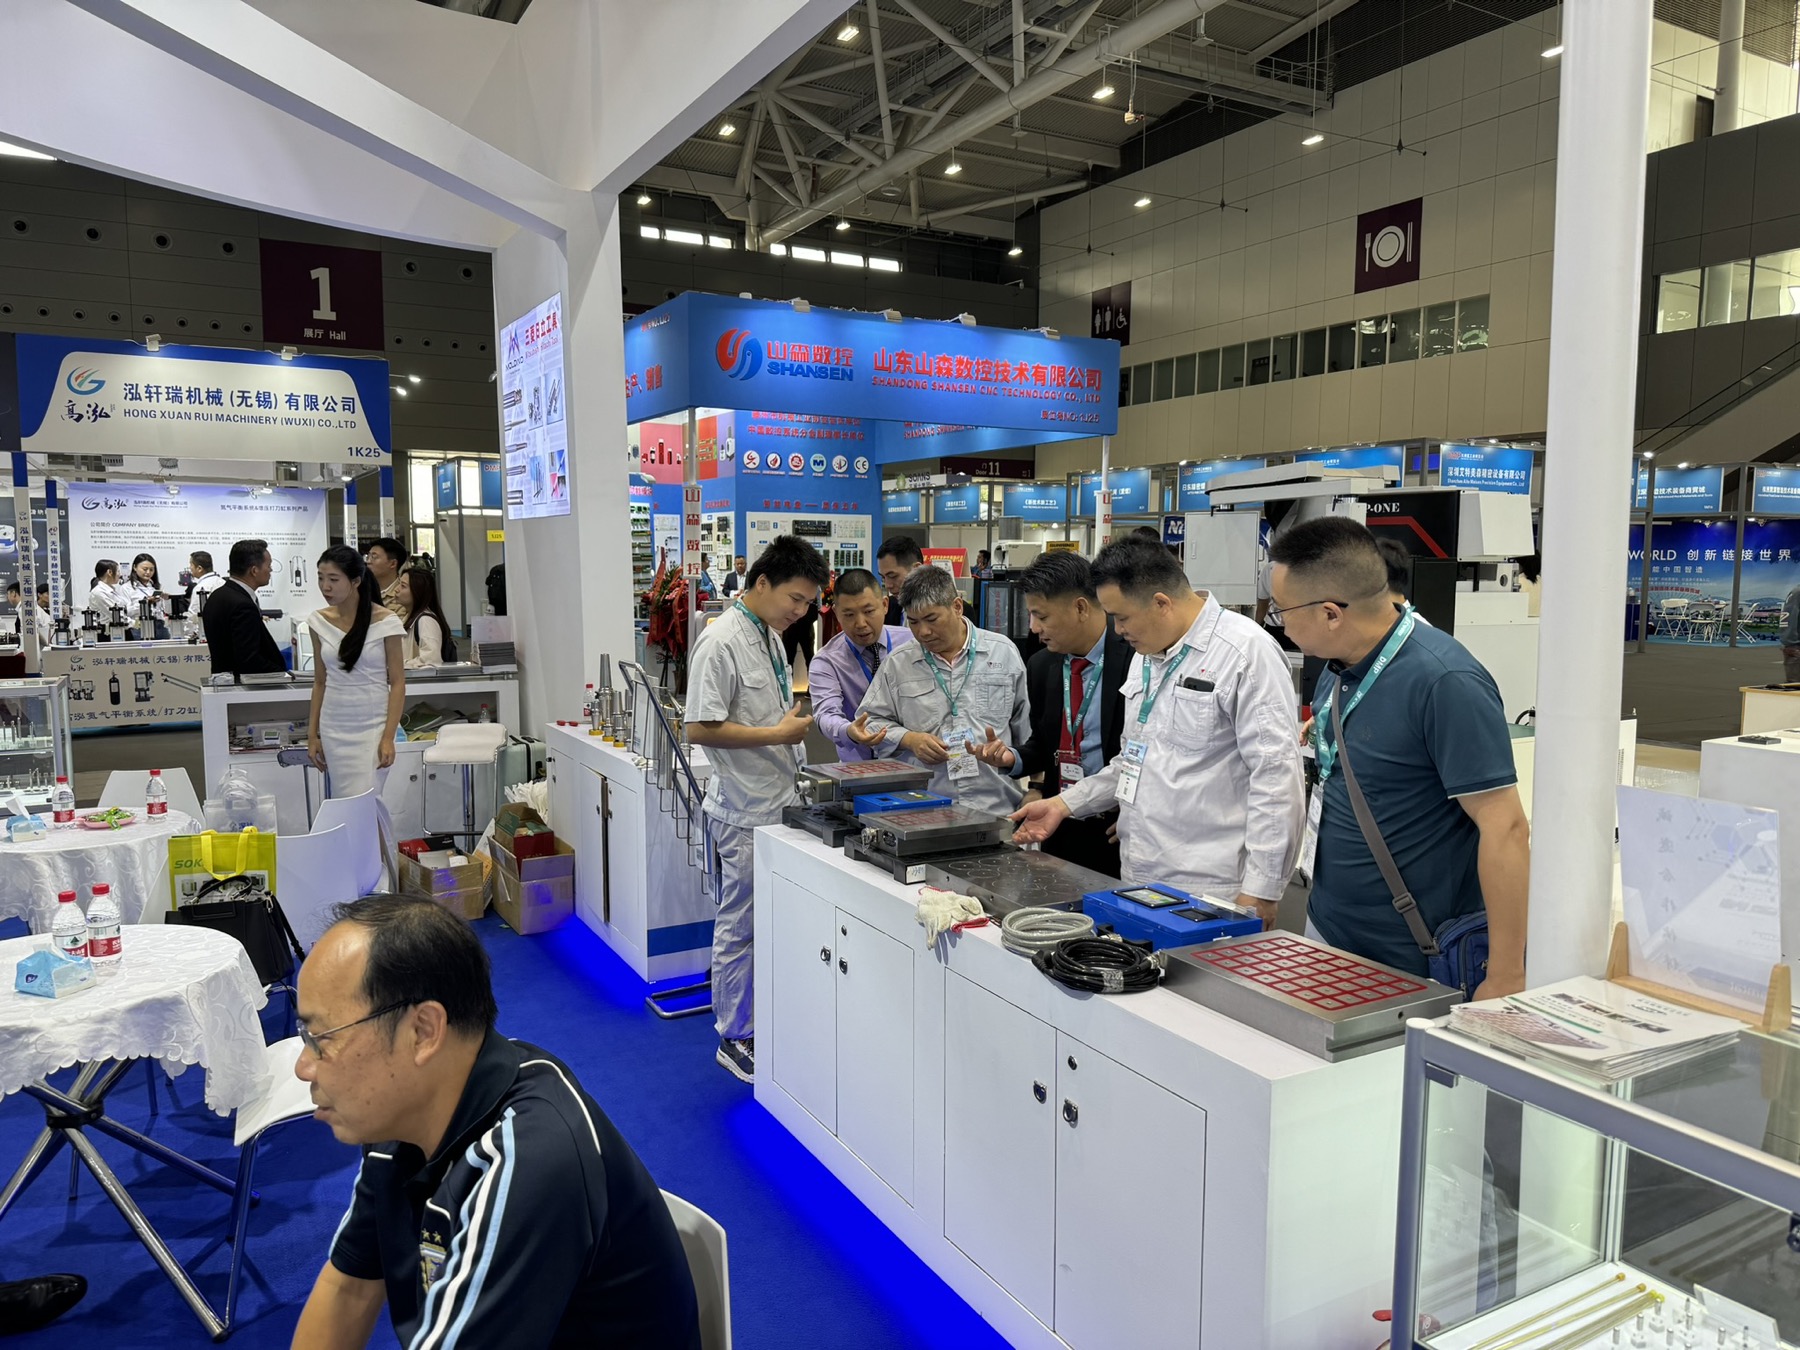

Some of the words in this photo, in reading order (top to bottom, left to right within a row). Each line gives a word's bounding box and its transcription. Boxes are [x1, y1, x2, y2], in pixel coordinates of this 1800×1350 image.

[310, 267, 337, 320] 1
[303, 328, 324, 339] 展厅
[329, 331, 347, 341] Hall
[525, 311, 558, 347] 三菱日立工具
[766, 360, 854, 381] SHANSEN
[873, 346, 1102, 392] 山东山森数控技术有限公司
[123, 382, 357, 415] 泓轩瑞机械（无锡）有限公司
[871, 375, 928, 390] SHANDONG
[931, 382, 977, 395] SHANSEN
[979, 386, 998, 396] CNC
[1001, 387, 1062, 401] TECHNOLOGY
[1063, 392, 1082, 404] CO.,
[1084, 393, 1101, 403] LTD
[123, 409, 157, 420] HONG
[160, 410, 192, 421] XUAN
[194, 412, 213, 422] RUI
[215, 413, 278, 425] MACHINERY
[280, 416, 316, 428] (WUXI)
[317, 418, 357, 429] CO.,LTD
[347, 445, 381, 458] 1K25
[988, 461, 1001, 476] 11
[1686, 549, 1792, 561] 创新链接世界
[1373, 656, 1387, 674] DMP
